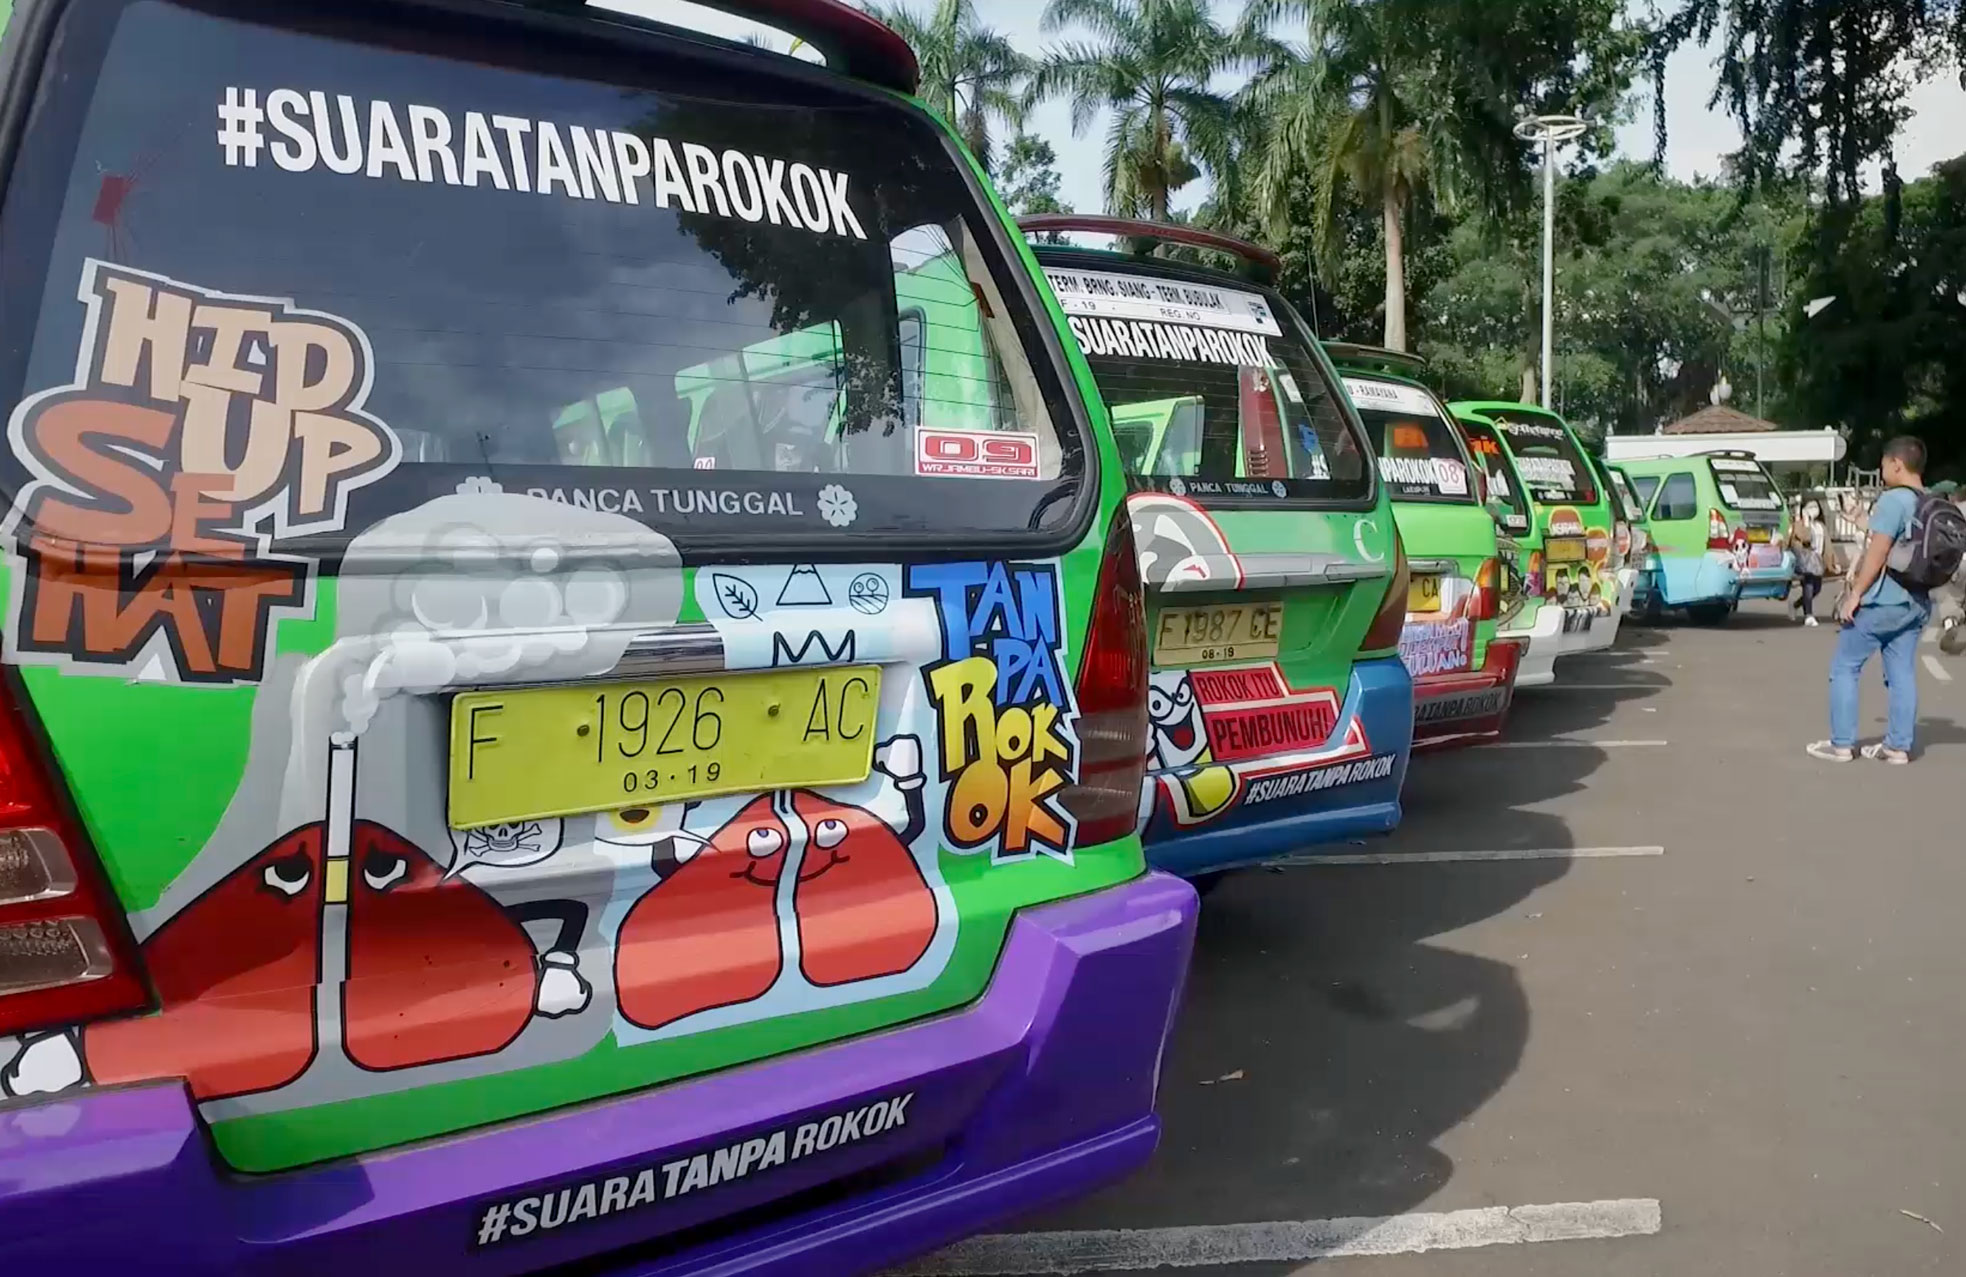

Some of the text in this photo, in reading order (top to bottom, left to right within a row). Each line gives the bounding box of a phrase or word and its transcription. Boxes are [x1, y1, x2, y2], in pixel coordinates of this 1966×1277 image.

[217, 86, 868, 240] #SUARATANPAROKOK
[925, 435, 1032, 464] 09
[1190, 482, 1268, 494] PANCA TUNGGAL
[1439, 463, 1459, 484] 08
[651, 488, 804, 516] TUNGGAL
[1159, 613, 1179, 648] F
[1184, 608, 1242, 644] 1987
[1195, 669, 1278, 703] ROKOK ITU
[468, 677, 869, 780] F 1926 AC
[1212, 706, 1330, 754] PEMBUNUH!
